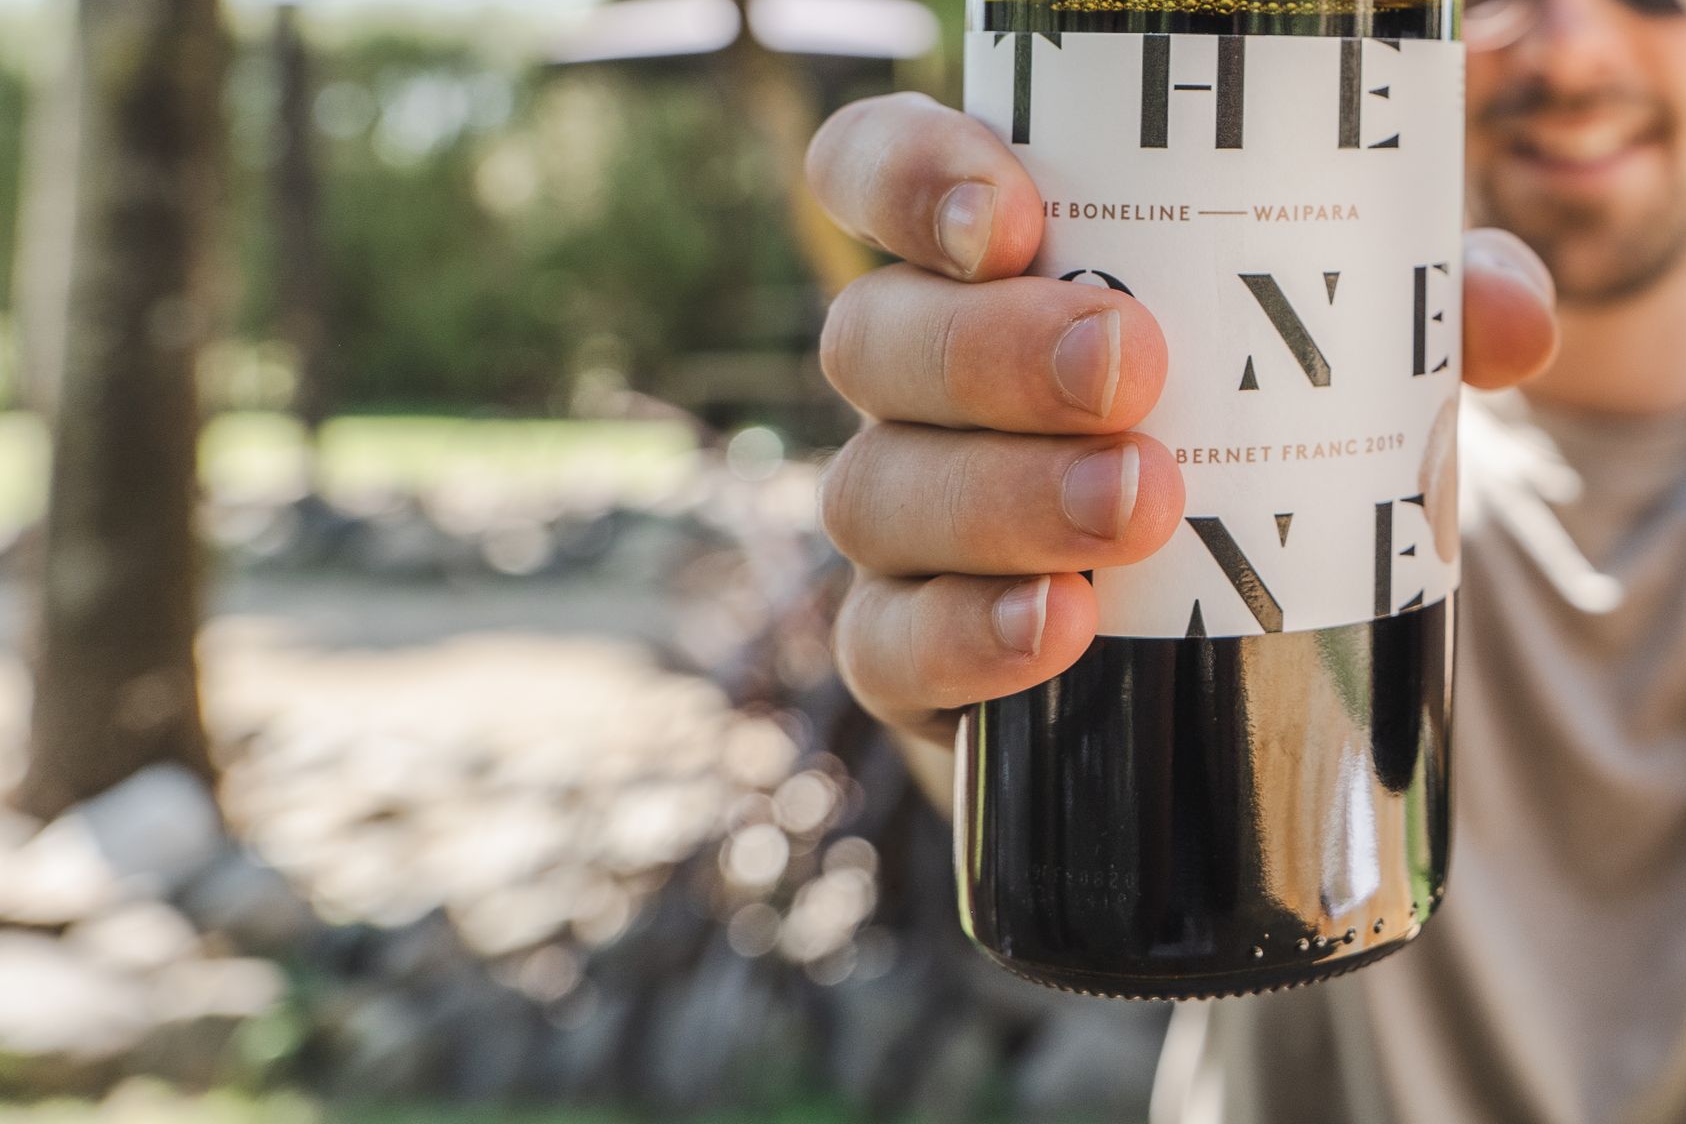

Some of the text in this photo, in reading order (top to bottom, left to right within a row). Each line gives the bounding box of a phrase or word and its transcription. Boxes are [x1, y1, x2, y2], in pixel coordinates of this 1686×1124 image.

[994, 33, 1402, 149] THE
[1069, 202, 1191, 221] BONELINE
[1254, 204, 1360, 221] WAIPARA
[1059, 264, 1449, 390] NE
[1175, 432, 1405, 464] BERNET FRANC 2019
